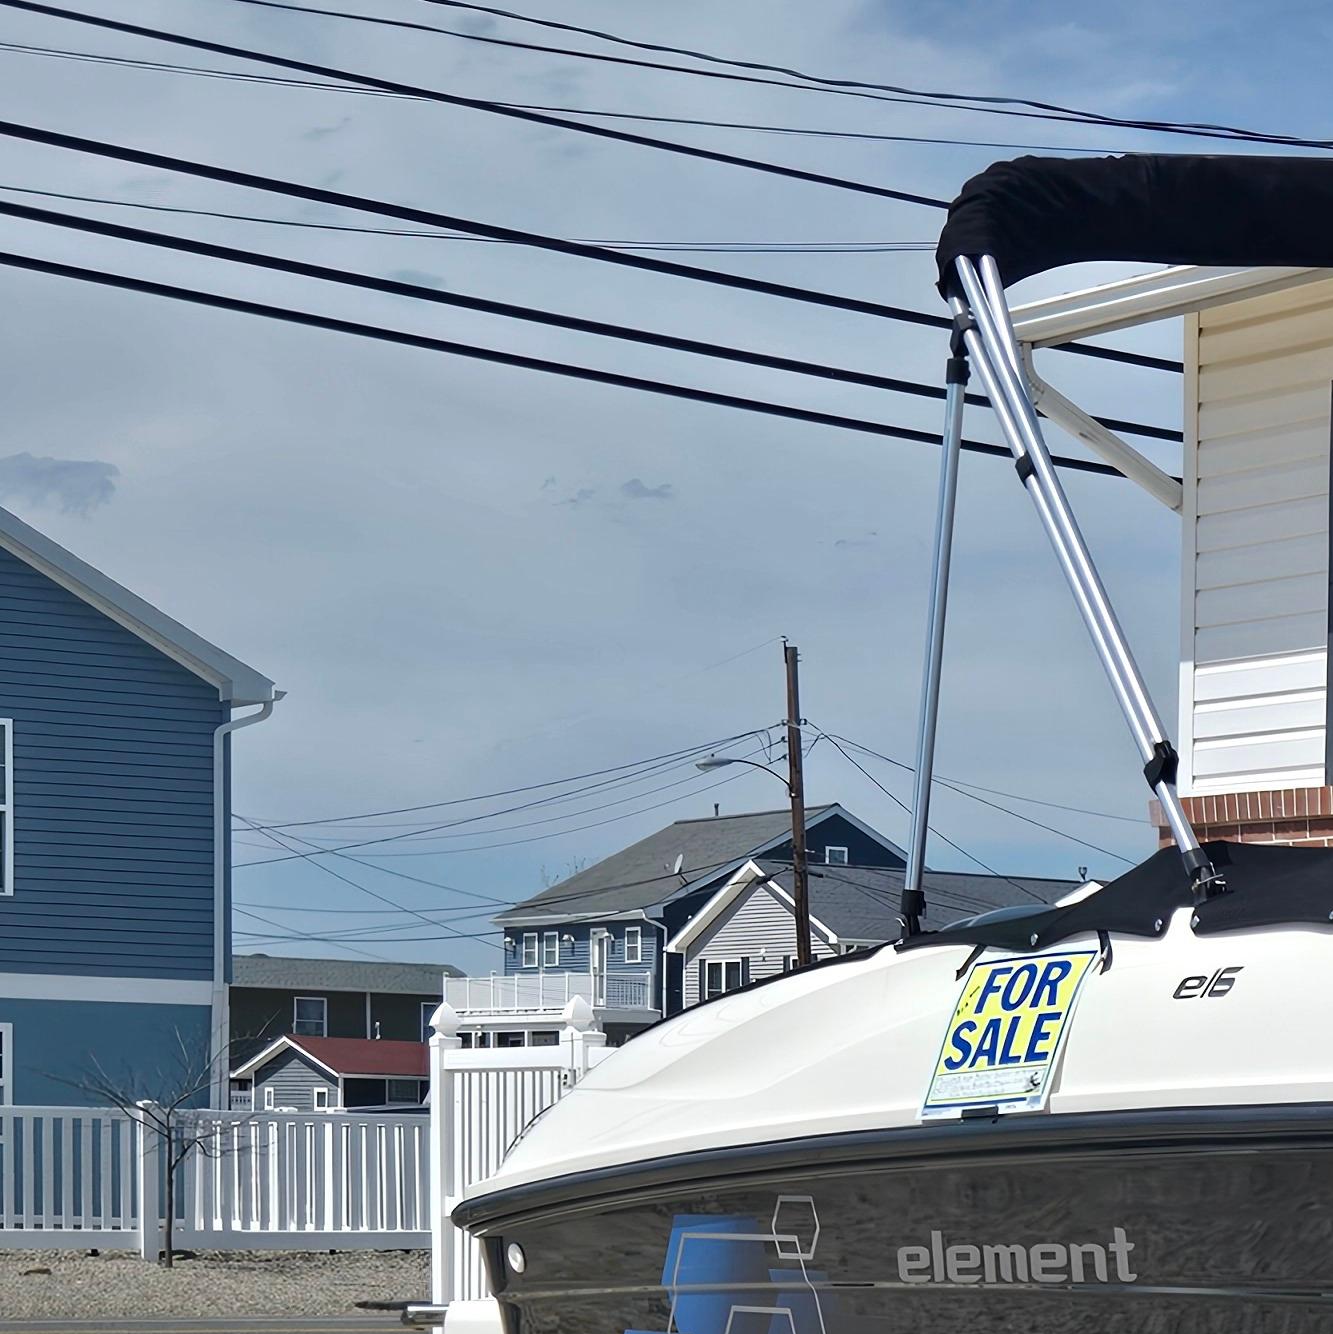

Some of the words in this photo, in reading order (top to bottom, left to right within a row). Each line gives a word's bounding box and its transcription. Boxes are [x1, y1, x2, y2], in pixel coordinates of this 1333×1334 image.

[975, 960, 1072, 1014] FOR
[944, 1012, 1062, 1070] SALE
[897, 1226, 1138, 1283] element
